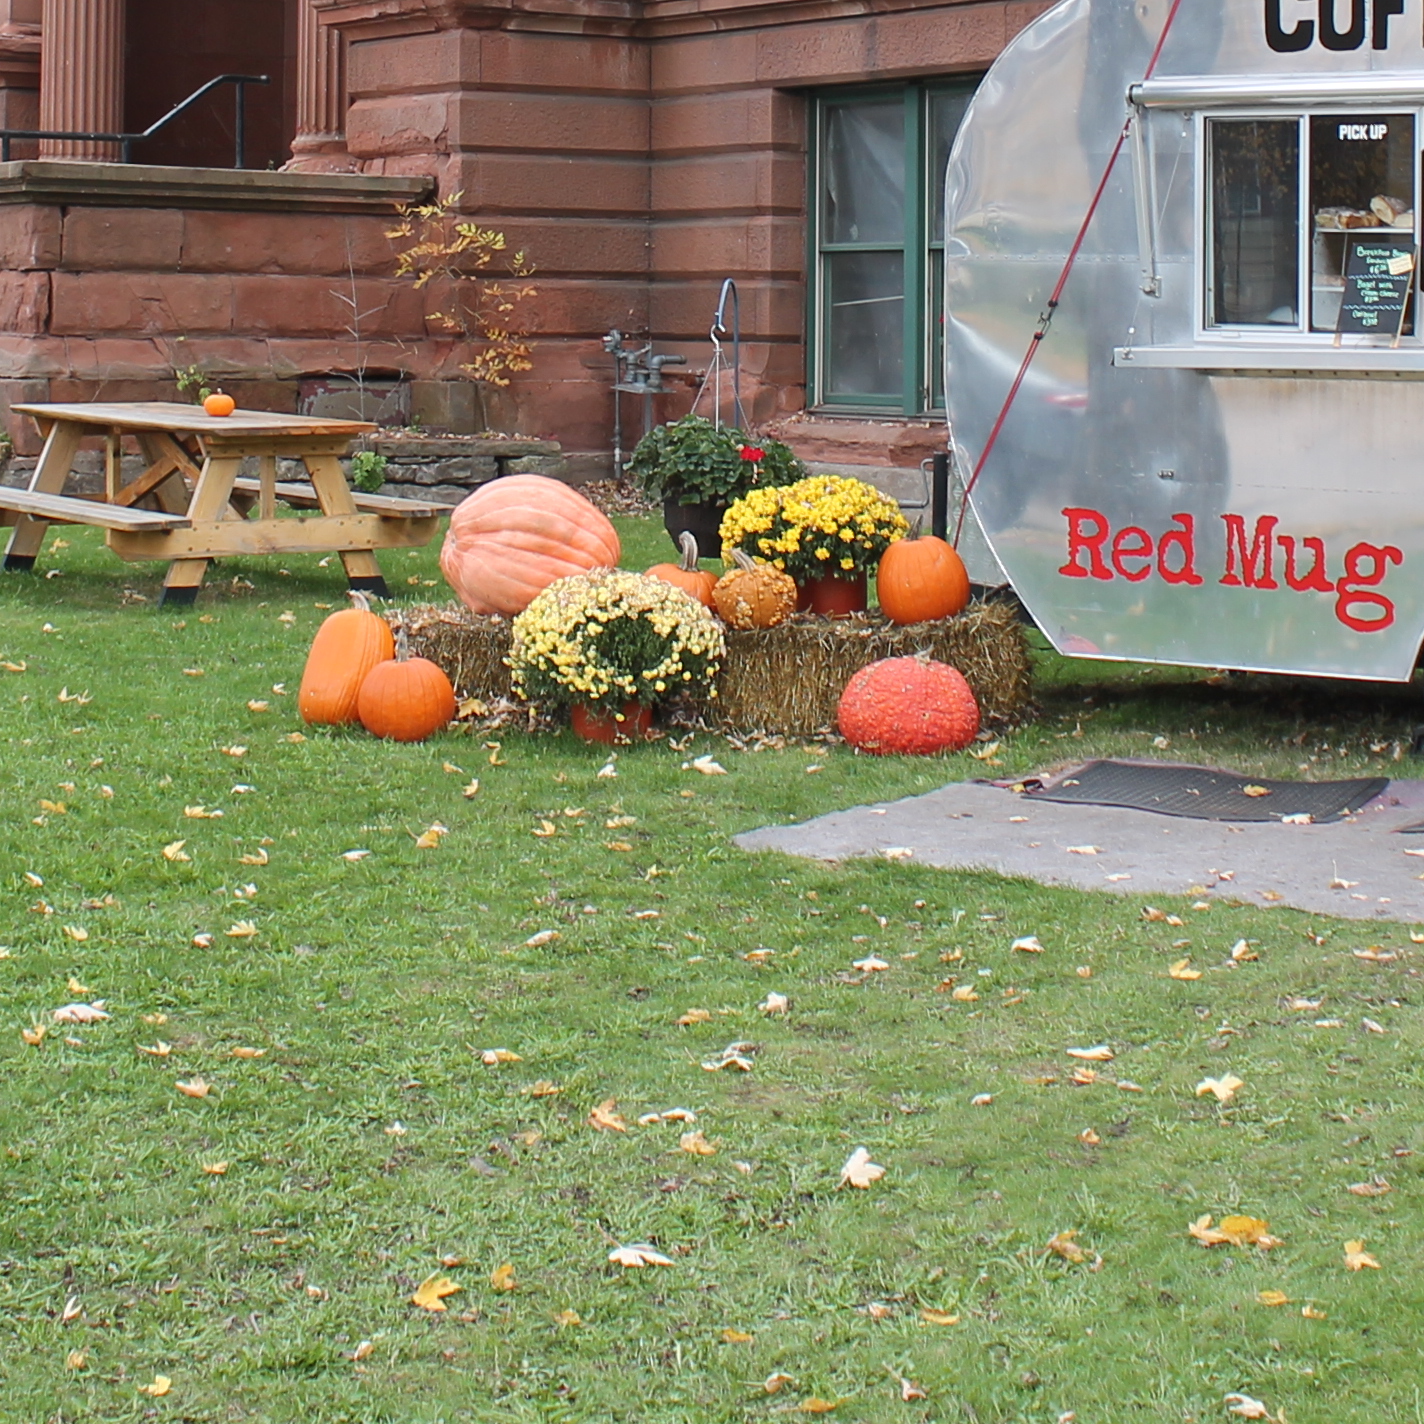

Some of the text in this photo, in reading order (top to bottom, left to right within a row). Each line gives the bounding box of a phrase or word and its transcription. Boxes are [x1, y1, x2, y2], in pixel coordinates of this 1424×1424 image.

[1338, 124, 1388, 140] PICK UP
[1058, 506, 1403, 632] Red Mug
